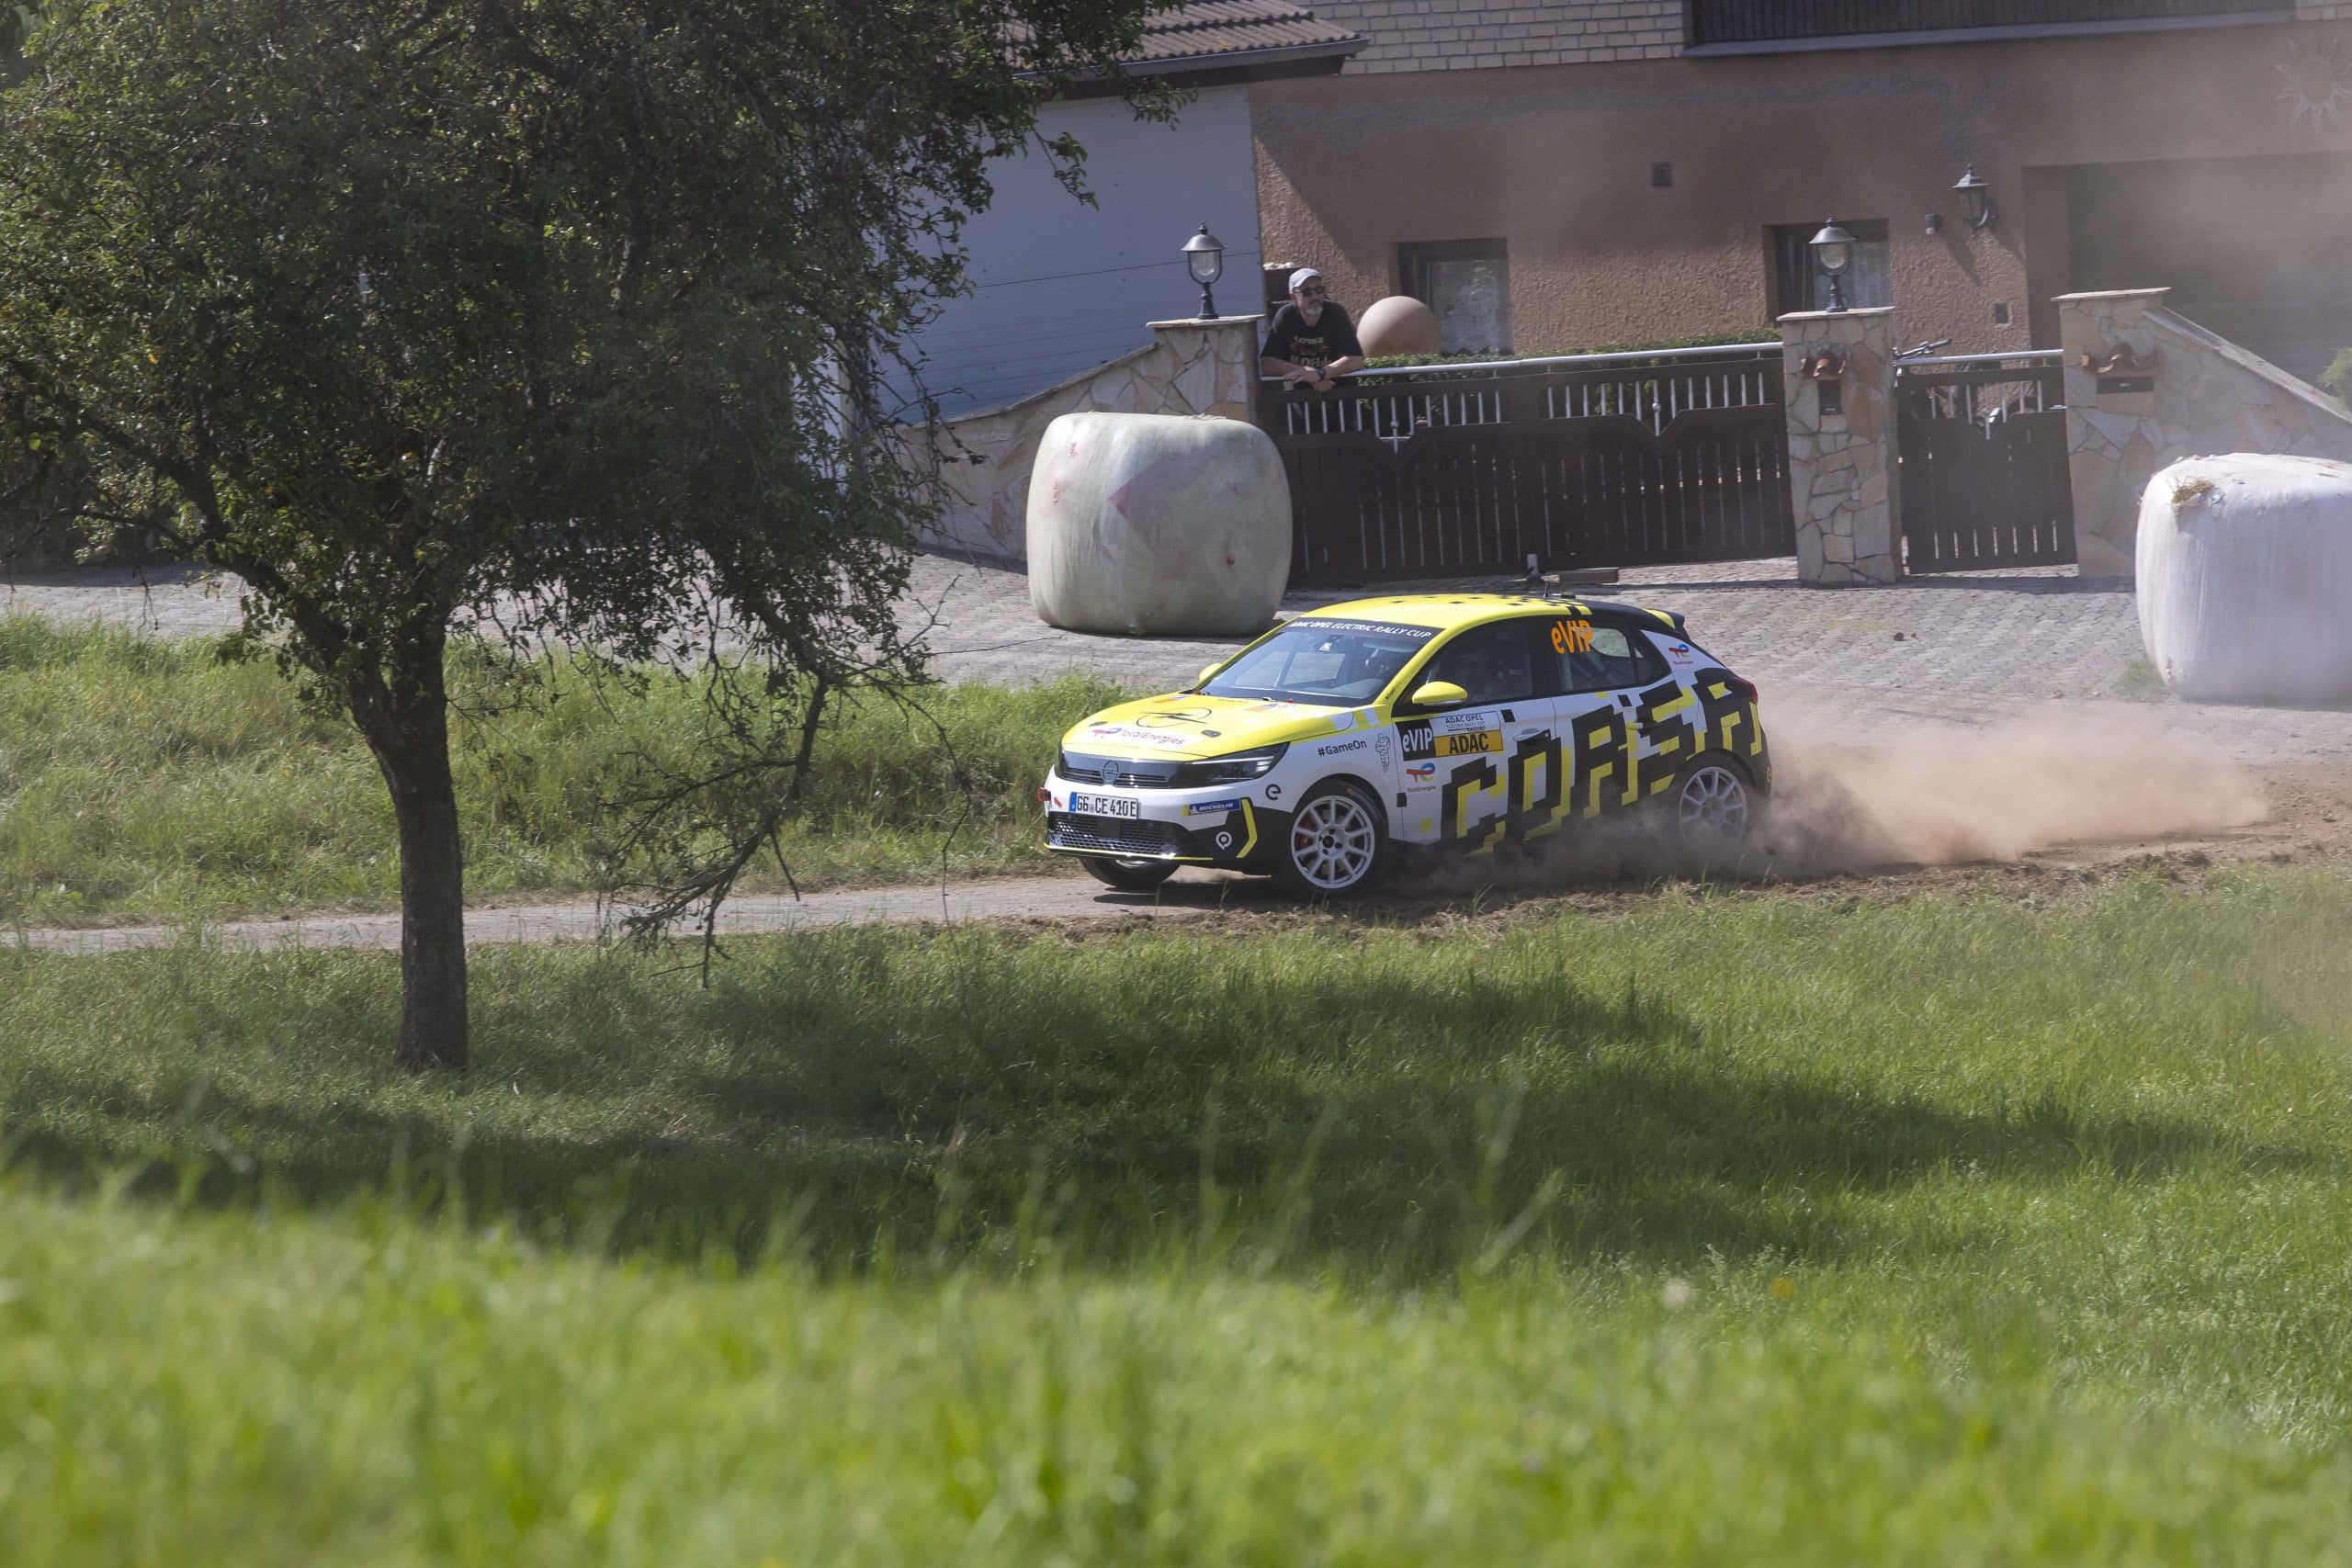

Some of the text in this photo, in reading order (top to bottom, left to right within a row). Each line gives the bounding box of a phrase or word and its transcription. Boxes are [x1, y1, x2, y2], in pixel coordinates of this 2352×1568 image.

[1331, 623, 1375, 631] ELECTRIC
[1374, 626, 1406, 635] RALLY
[1406, 630, 1431, 638] CUP
[1551, 619, 1593, 655] eVIP
[1445, 716, 1465, 724] ADAC
[1317, 739, 1367, 757] #GameOn
[1402, 728, 1433, 752] eVIP
[1449, 733, 1489, 754] ADAC
[1095, 797, 1109, 815] CE
